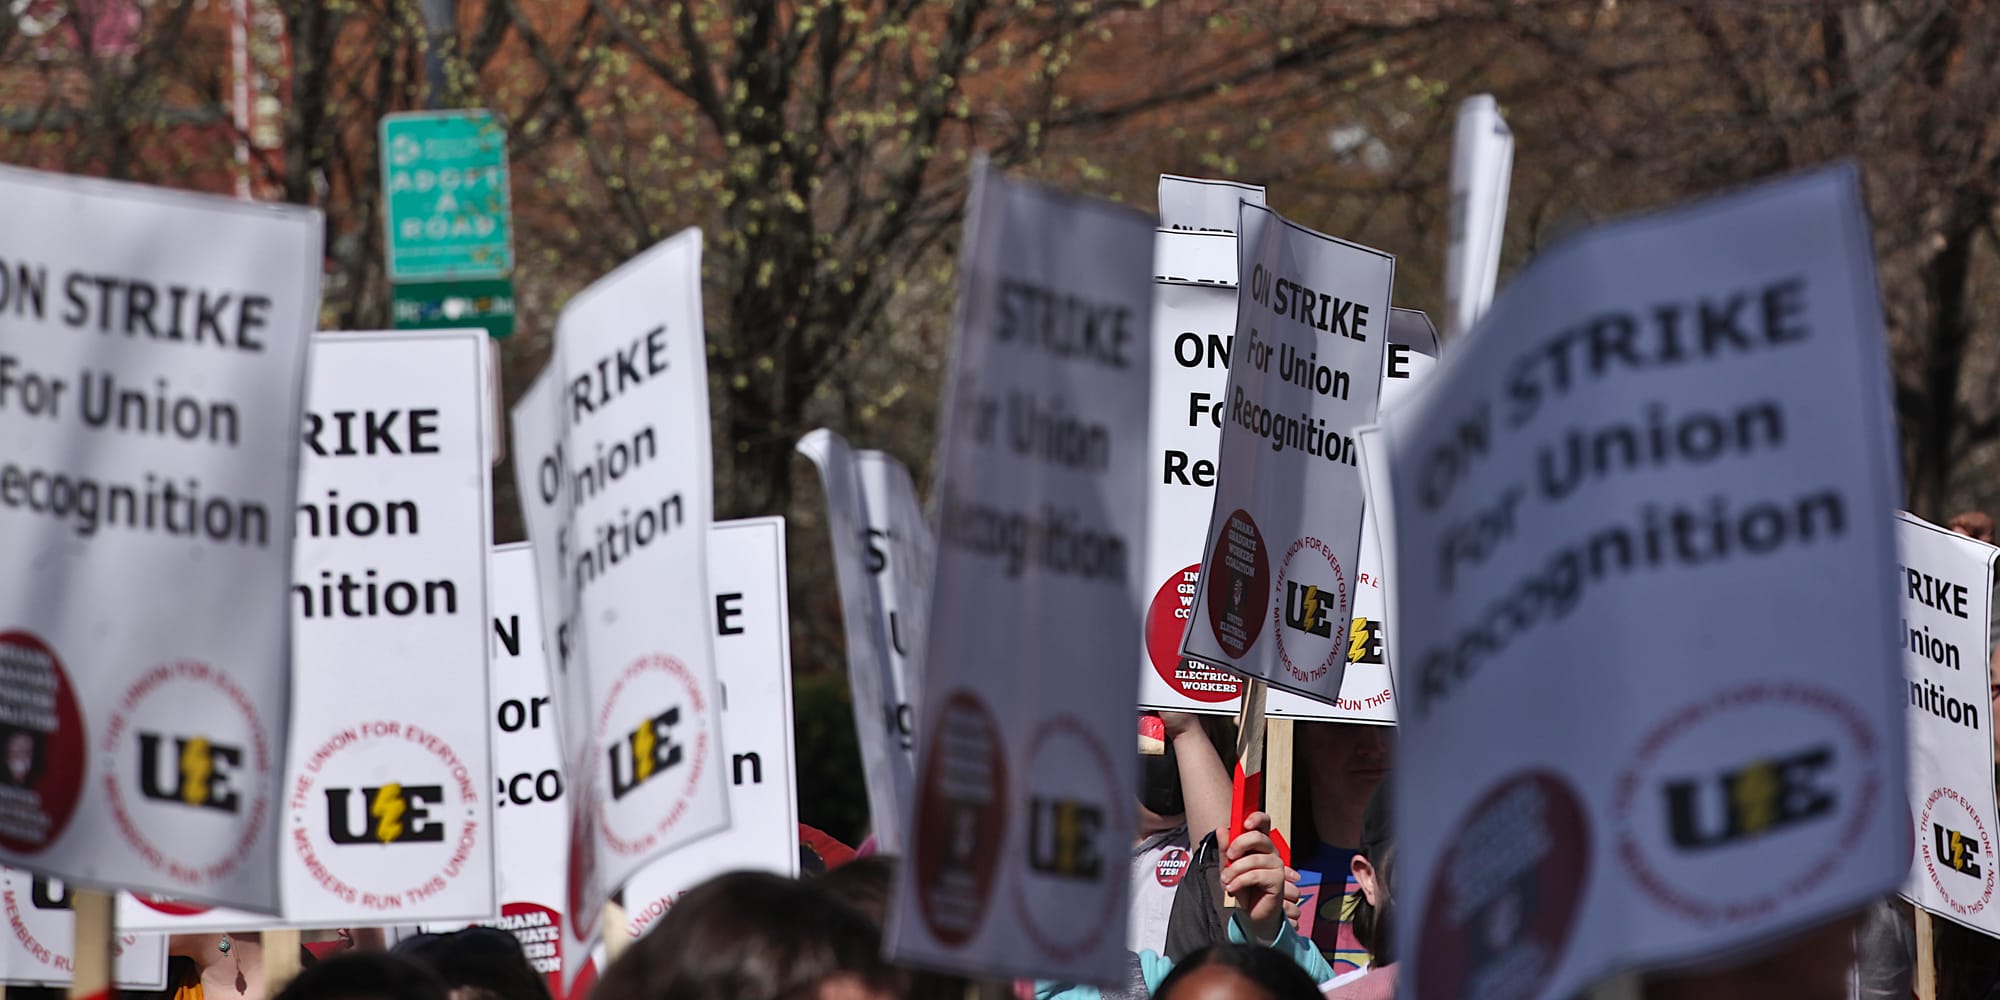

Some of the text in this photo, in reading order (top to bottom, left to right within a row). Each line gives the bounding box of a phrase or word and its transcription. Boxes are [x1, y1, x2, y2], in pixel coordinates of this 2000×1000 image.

[391, 165, 500, 193] ADOPT
[436, 193, 459, 214] A
[401, 215, 496, 241] ROAD
[62, 270, 272, 352] STRIKE
[996, 278, 1134, 369] STRIKE
[1252, 263, 1370, 343] ON STRIKE
[570, 324, 670, 425] RIKE
[1247, 328, 1274, 374] For
[1279, 342, 1351, 401] Union
[1506, 275, 1811, 430] STRIKE
[80, 368, 240, 446] Union
[303, 409, 440, 457] RIKE
[1232, 385, 1357, 467] Recognition
[0, 463, 271, 546] ecognition
[573, 428, 656, 506] nion
[1438, 398, 1786, 593] For Union
[297, 490, 418, 537] nion
[574, 491, 683, 589] nition
[292, 568, 457, 618] nition
[1276, 565, 1286, 593] THE
[1284, 538, 1304, 567] UNION
[1305, 536, 1322, 552] FOR
[1321, 544, 1347, 613] EVERYONE
[1285, 579, 1335, 639] UE
[1413, 487, 1848, 719] Recognition
[1905, 567, 1969, 620] RIKE
[1273, 607, 1344, 683] MEMBERS RUN THIS UNION
[497, 695, 551, 732] or
[1181, 681, 1238, 693] WORKERS
[1365, 689, 1392, 709] THIS
[1908, 678, 1980, 730] nition
[136, 731, 243, 815] UE
[305, 727, 358, 773] UNION
[361, 720, 401, 738] FOR
[404, 724, 477, 804] EVERYONE
[609, 705, 683, 802] UE
[324, 784, 445, 845] UE
[1660, 745, 1839, 854] UE
[1920, 786, 1994, 859] THE UNION FOR EVERYONE
[292, 820, 478, 910] MEMBERS RUN THIS UNION
[1029, 796, 1104, 884] UE
[1157, 860, 1187, 868] UNION
[1160, 867, 1179, 876] YES!
[1933, 822, 1982, 880] UE
[1921, 843, 1995, 916] MEMBERS RUN THIS UNION
[3, 889, 77, 973] MEMBERS RU
